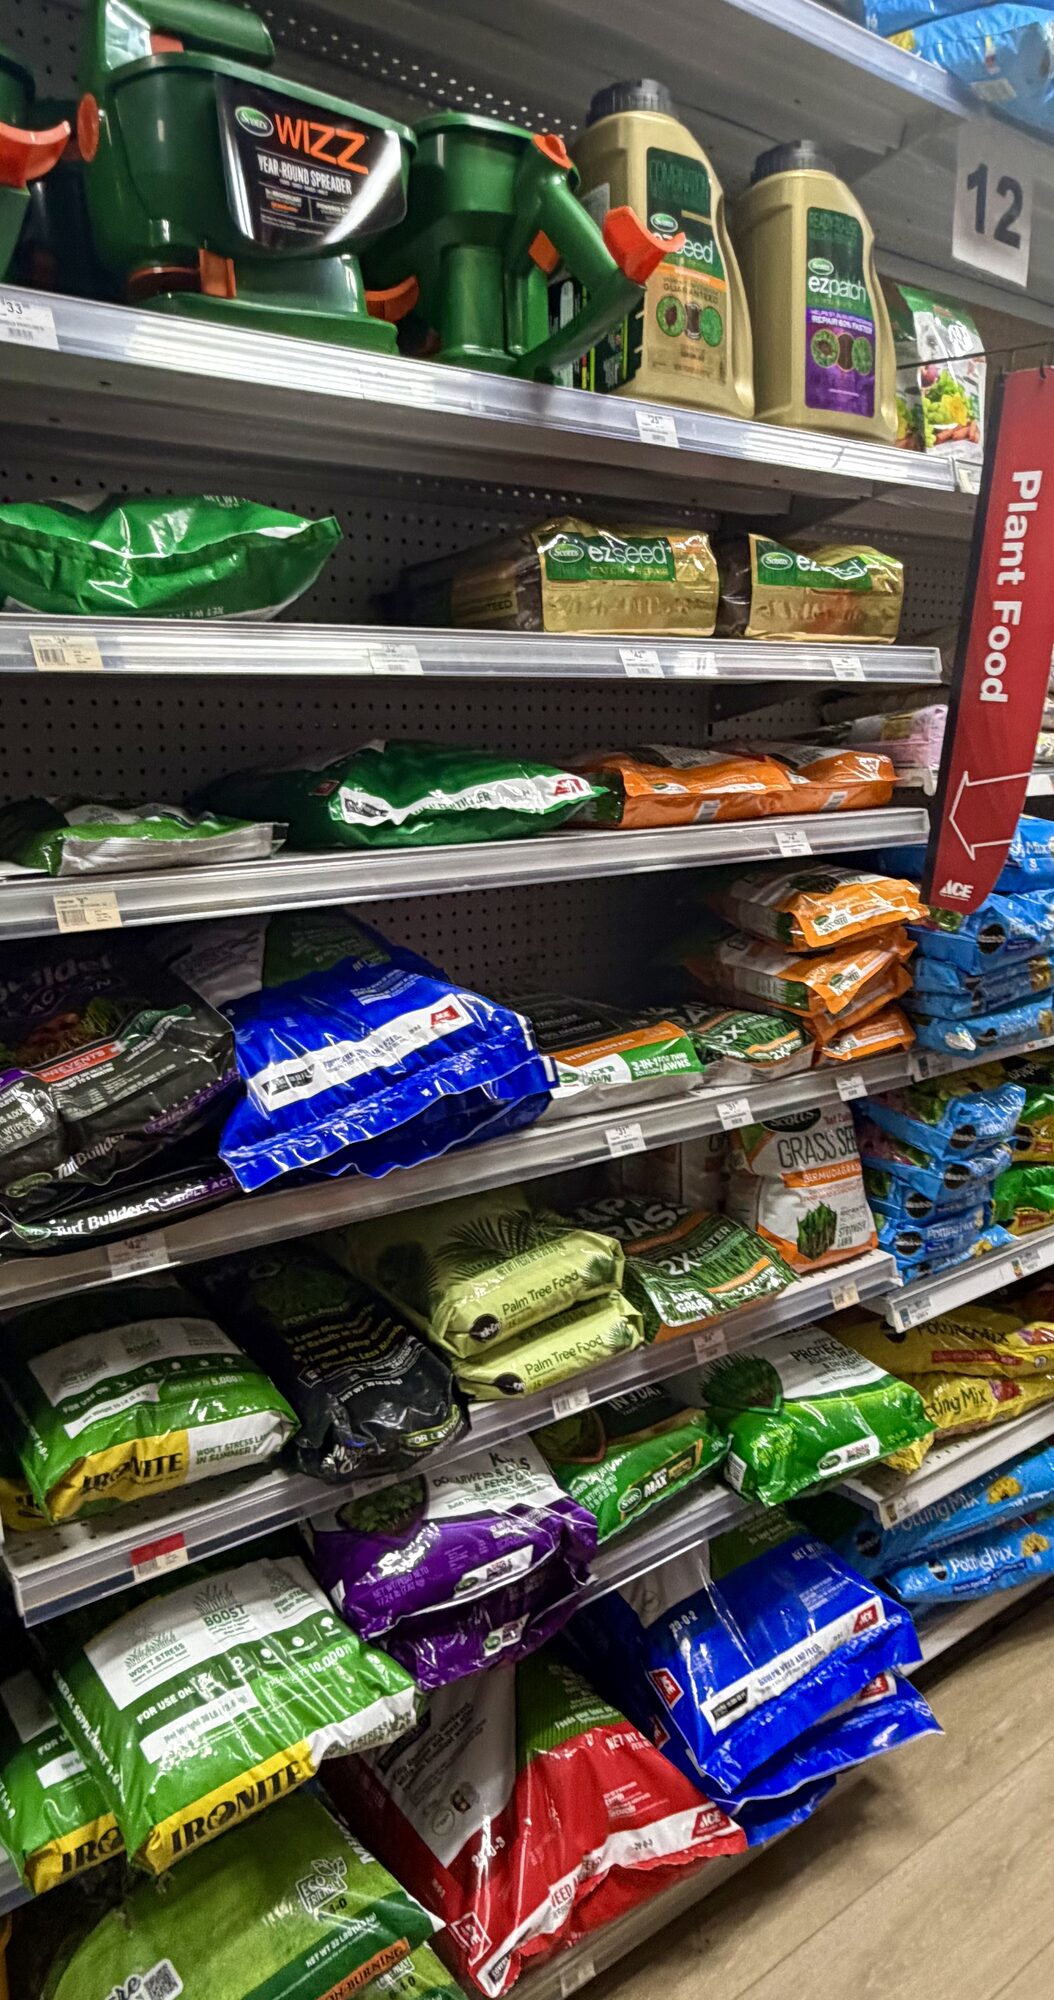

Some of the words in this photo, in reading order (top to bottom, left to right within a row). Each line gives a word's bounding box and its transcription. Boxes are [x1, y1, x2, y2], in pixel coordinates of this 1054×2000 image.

[275, 113, 369, 175] WIZZ
[257, 153, 310, 188] YEAR-ROUND
[310, 169, 353, 196] SPREADER
[967, 163, 1024, 250] 12
[808, 276, 867, 304] ezpatch
[997, 469, 1043, 587] Plant
[588, 540, 668, 565] ezseed
[979, 600, 1023, 703] Food
[940, 879, 974, 900] ACE
[713, 1025, 747, 1044] 2X
[42, 1049, 107, 1079] PREVENTS
[631, 1058, 659, 1072] 3-IN-1
[660, 1060, 692, 1073] LAWNS
[74, 1132, 126, 1168] Builder
[777, 1131, 839, 1169] GRASS
[211, 1175, 235, 1193] ACT
[55, 1219, 85, 1238] Turf
[658, 1250, 701, 1276] 2X
[693, 1224, 732, 1260] FASTER
[502, 1296, 529, 1316] Palm
[528, 1284, 553, 1303] Tree
[552, 1269, 580, 1291] Food
[740, 1281, 762, 1297] 2X
[524, 1356, 554, 1376] Palm
[551, 1345, 577, 1365] Tree
[575, 1334, 604, 1355] Food
[789, 1340, 845, 1362] PROTEC
[960, 1385, 988, 1409] Mix
[195, 1445, 222, 1458] WON'T
[222, 1438, 255, 1454] STRESS
[195, 1454, 207, 1465] IN
[207, 1446, 251, 1463] SUMMER
[82, 1453, 184, 1494] IRONITE
[643, 1475, 668, 1498] MAX
[950, 1486, 980, 1512] Mix
[203, 1604, 246, 1627] BOOST
[128, 1659, 156, 1679] WON'T
[156, 1642, 186, 1663] STRESS
[136, 1708, 158, 1725] FOR
[157, 1694, 178, 1712] USE
[37, 1738, 59, 1756] FOR
[606, 1735, 625, 1750] NET
[171, 1759, 303, 1855] IRONITE
[699, 1811, 723, 1829] ACE
[301, 1875, 326, 1896] ECO
[305, 1878, 343, 1907] FRIENDLY
[305, 1953, 320, 1969] NET
[320, 1946, 331, 1959] WT
